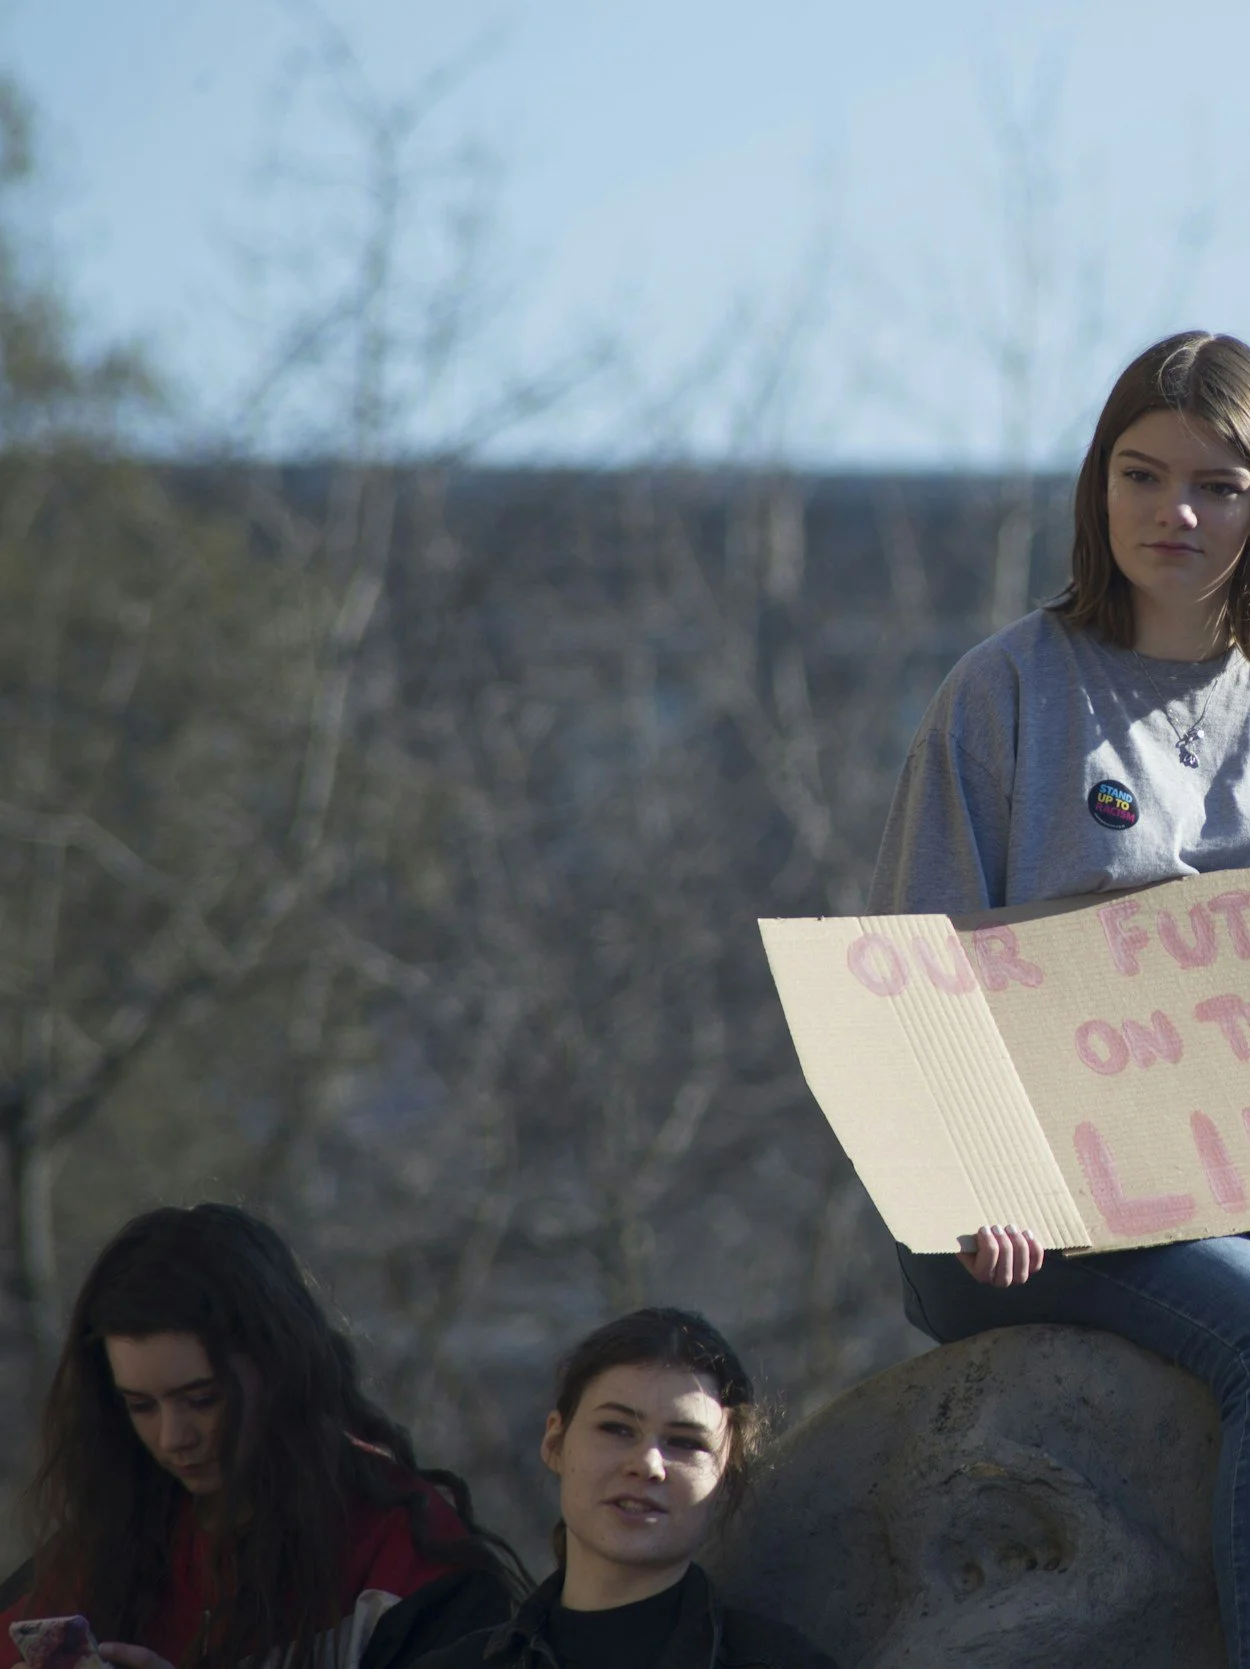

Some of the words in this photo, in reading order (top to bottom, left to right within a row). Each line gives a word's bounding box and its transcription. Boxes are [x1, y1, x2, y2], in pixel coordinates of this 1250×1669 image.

[1097, 792, 1113, 804] UP
[1115, 798, 1130, 811] TO
[1099, 783, 1133, 803] STAND
[846, 923, 1044, 998] OUR
[1073, 1008, 1185, 1076] ON
